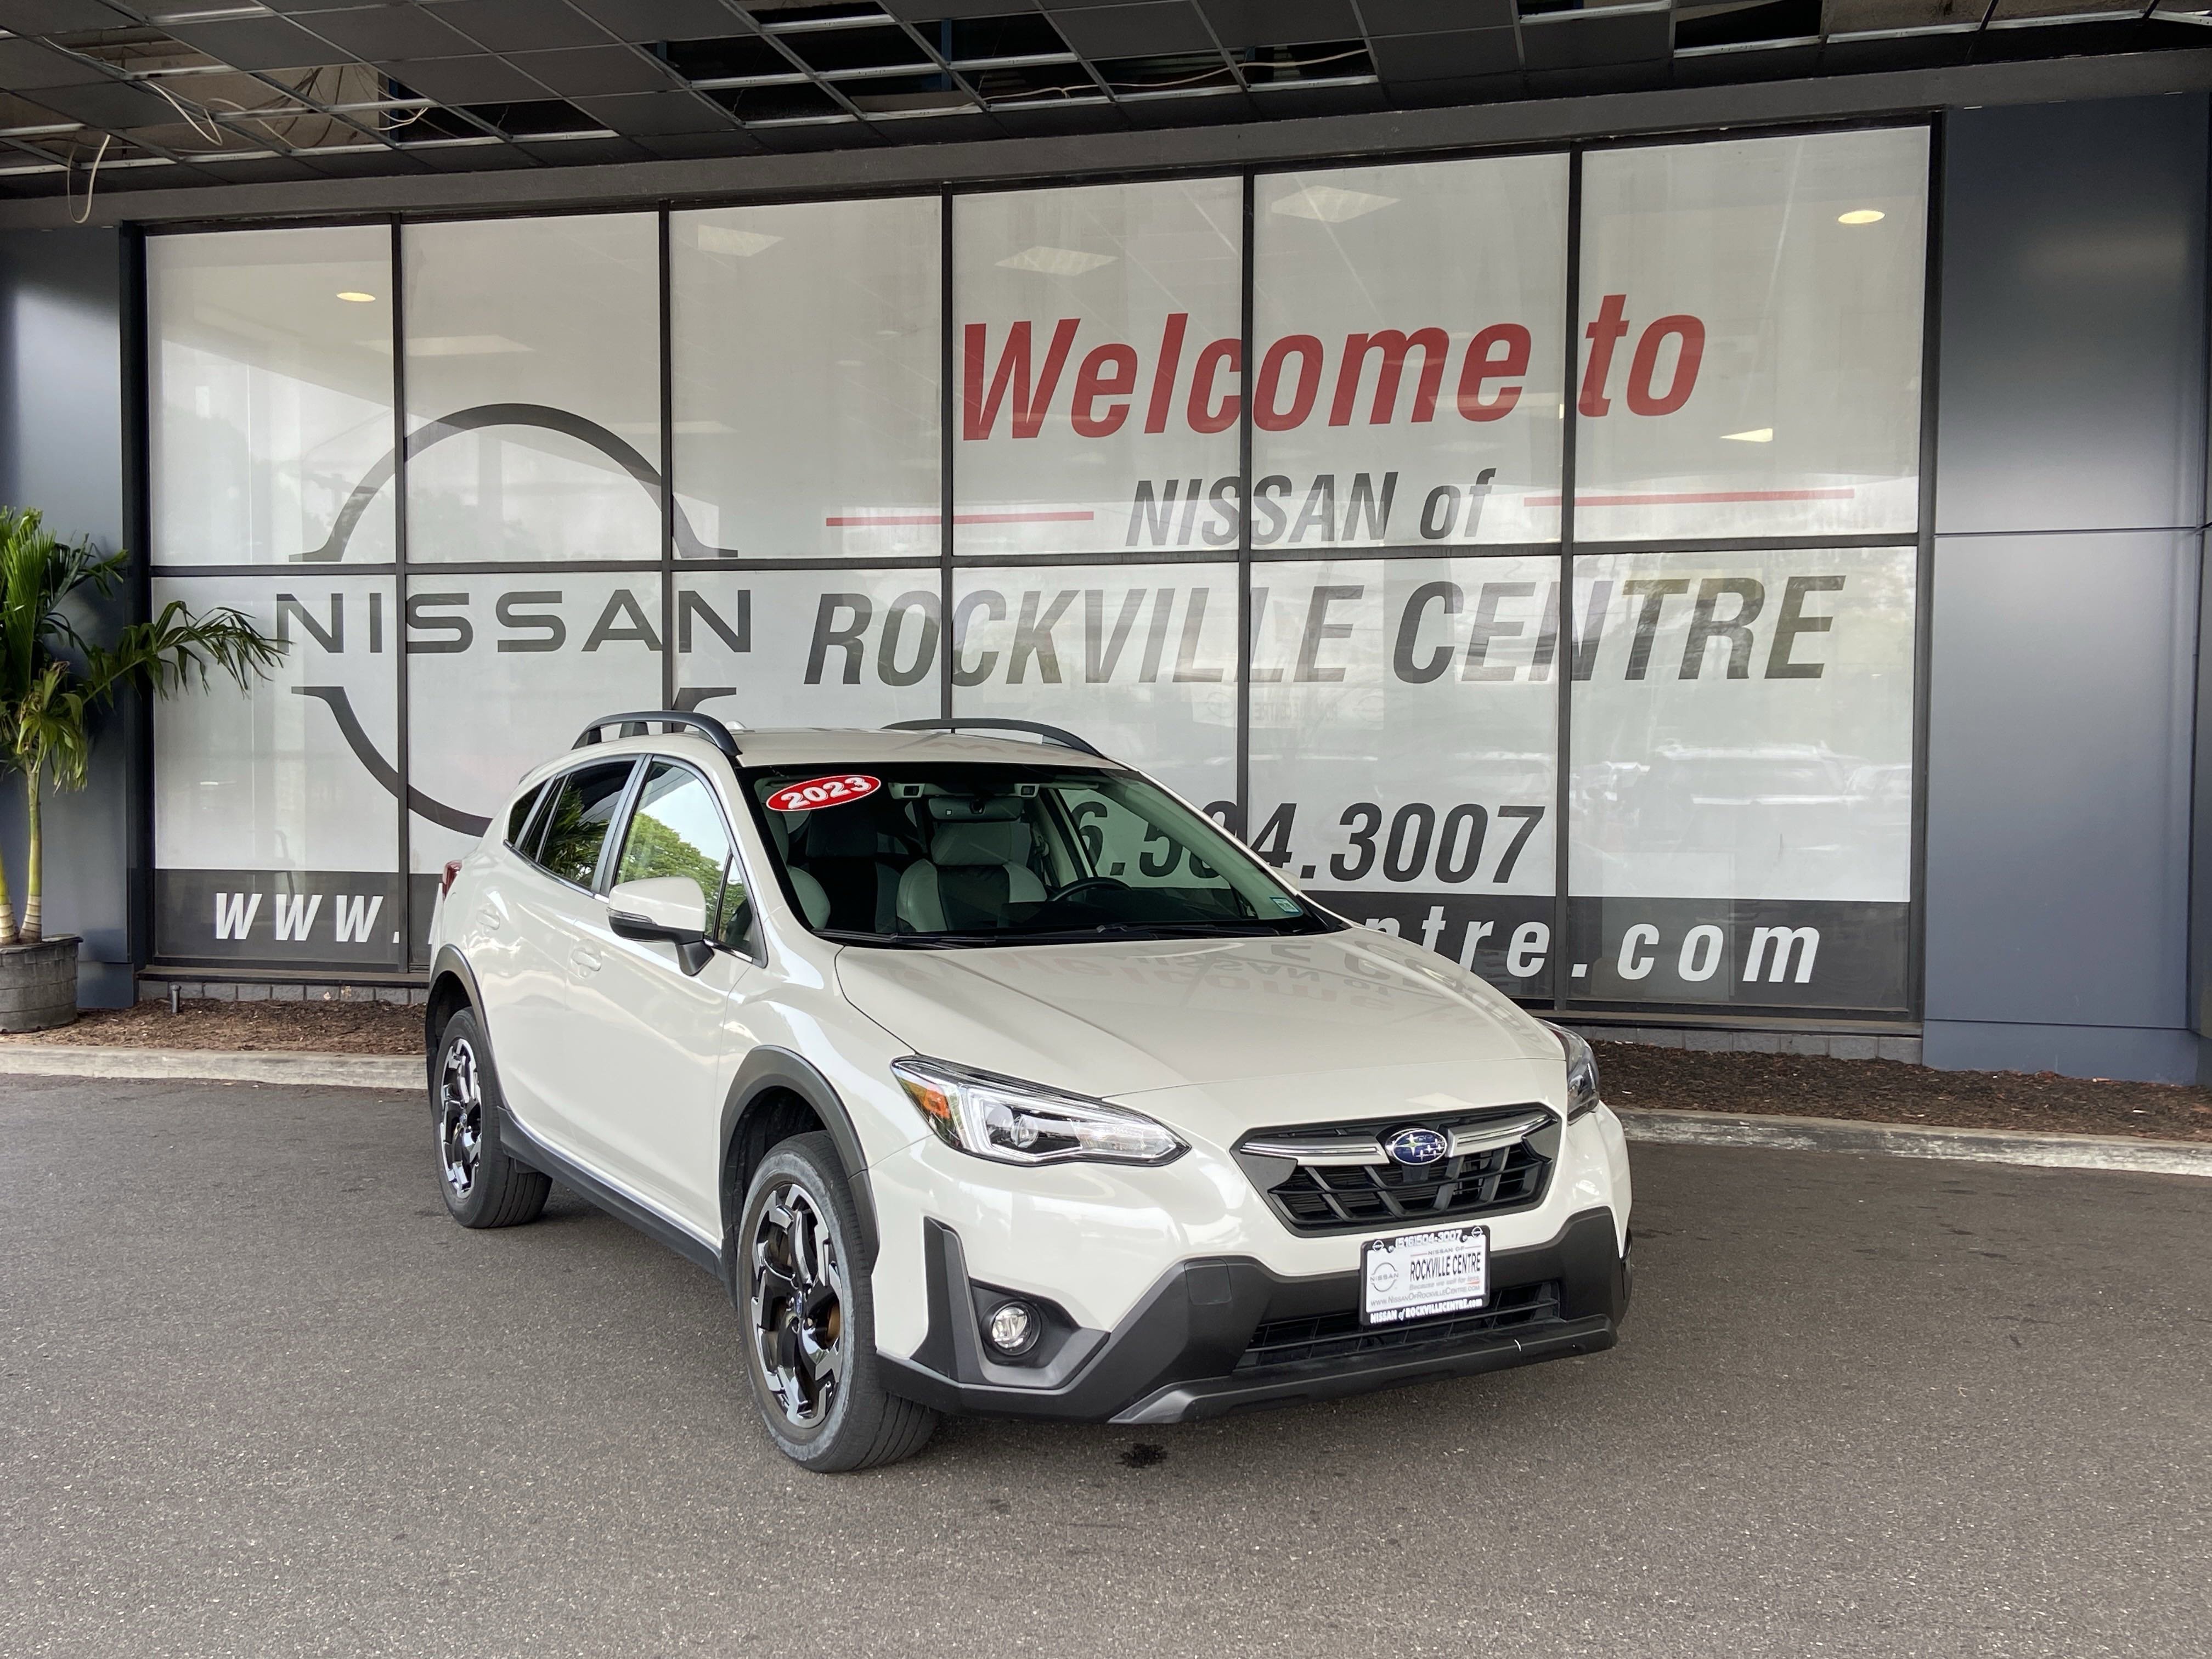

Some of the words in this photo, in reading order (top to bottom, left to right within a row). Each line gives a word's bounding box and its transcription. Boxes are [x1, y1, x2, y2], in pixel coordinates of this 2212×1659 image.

[963, 313, 1531, 441] Welcome
[1578, 294, 1706, 417] to
[1126, 471, 1398, 546] NISSAN
[1419, 468, 1496, 540] of
[276, 589, 751, 653] NISSAN
[804, 585, 1364, 687] ROCKVILLE
[1392, 575, 1847, 684] CENTRE
[781, 777, 872, 809] 2023
[216, 882, 443, 945] www.
[1370, 1273, 1399, 1282] NISSAN
[1410, 1256, 1451, 1282] ROCKVILLE
[1453, 1252, 1481, 1274] CENTRE
[1370, 1310, 1397, 1323] NISSAN
[1398, 1308, 1406, 1321] of
